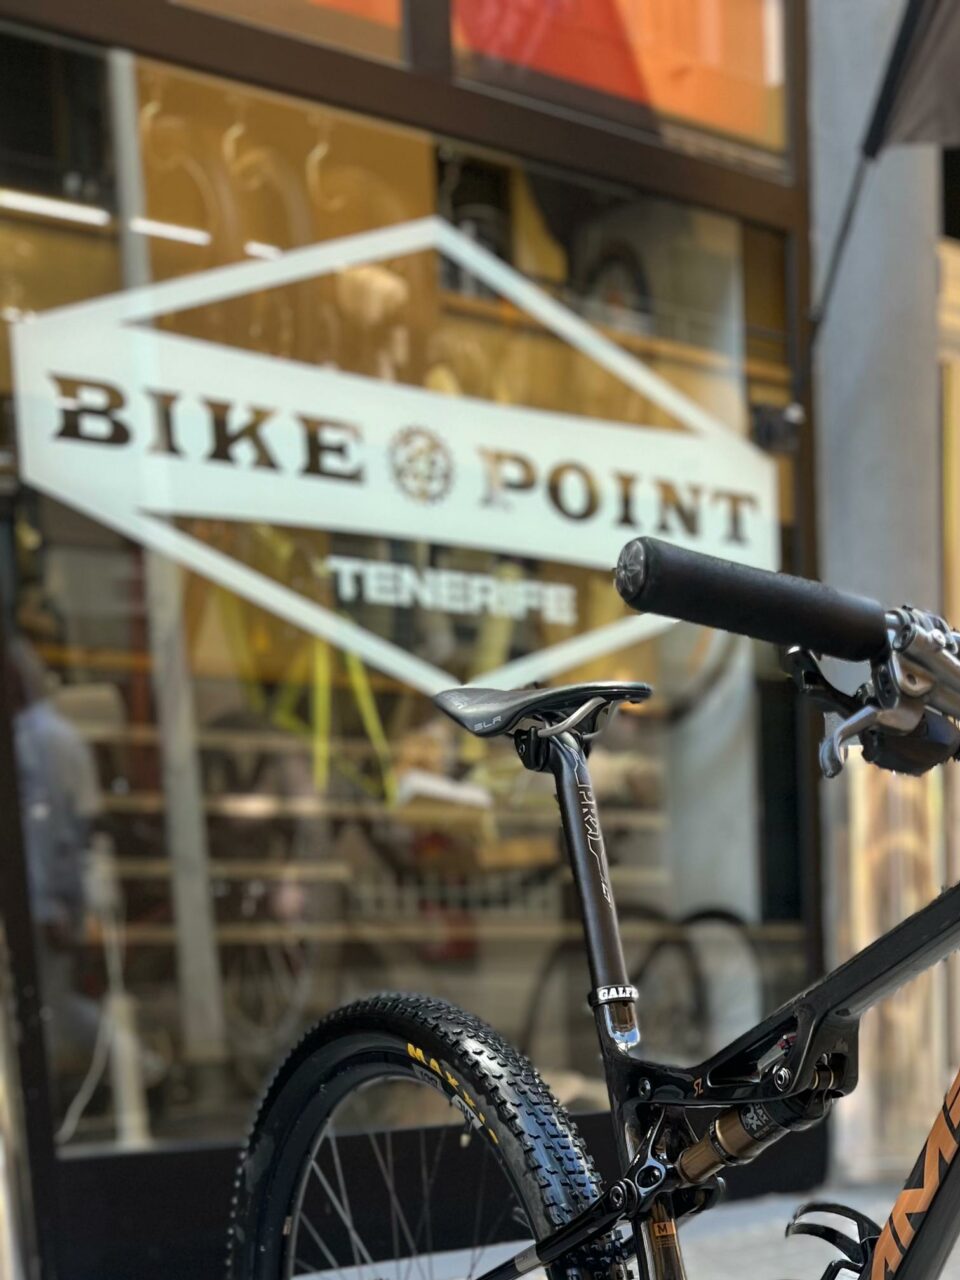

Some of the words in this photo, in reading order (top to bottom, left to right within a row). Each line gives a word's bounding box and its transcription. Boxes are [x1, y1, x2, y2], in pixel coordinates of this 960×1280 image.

[48, 374, 367, 485] BIKE
[476, 447, 760, 545] POINT
[328, 554, 578, 625] TENERIFE
